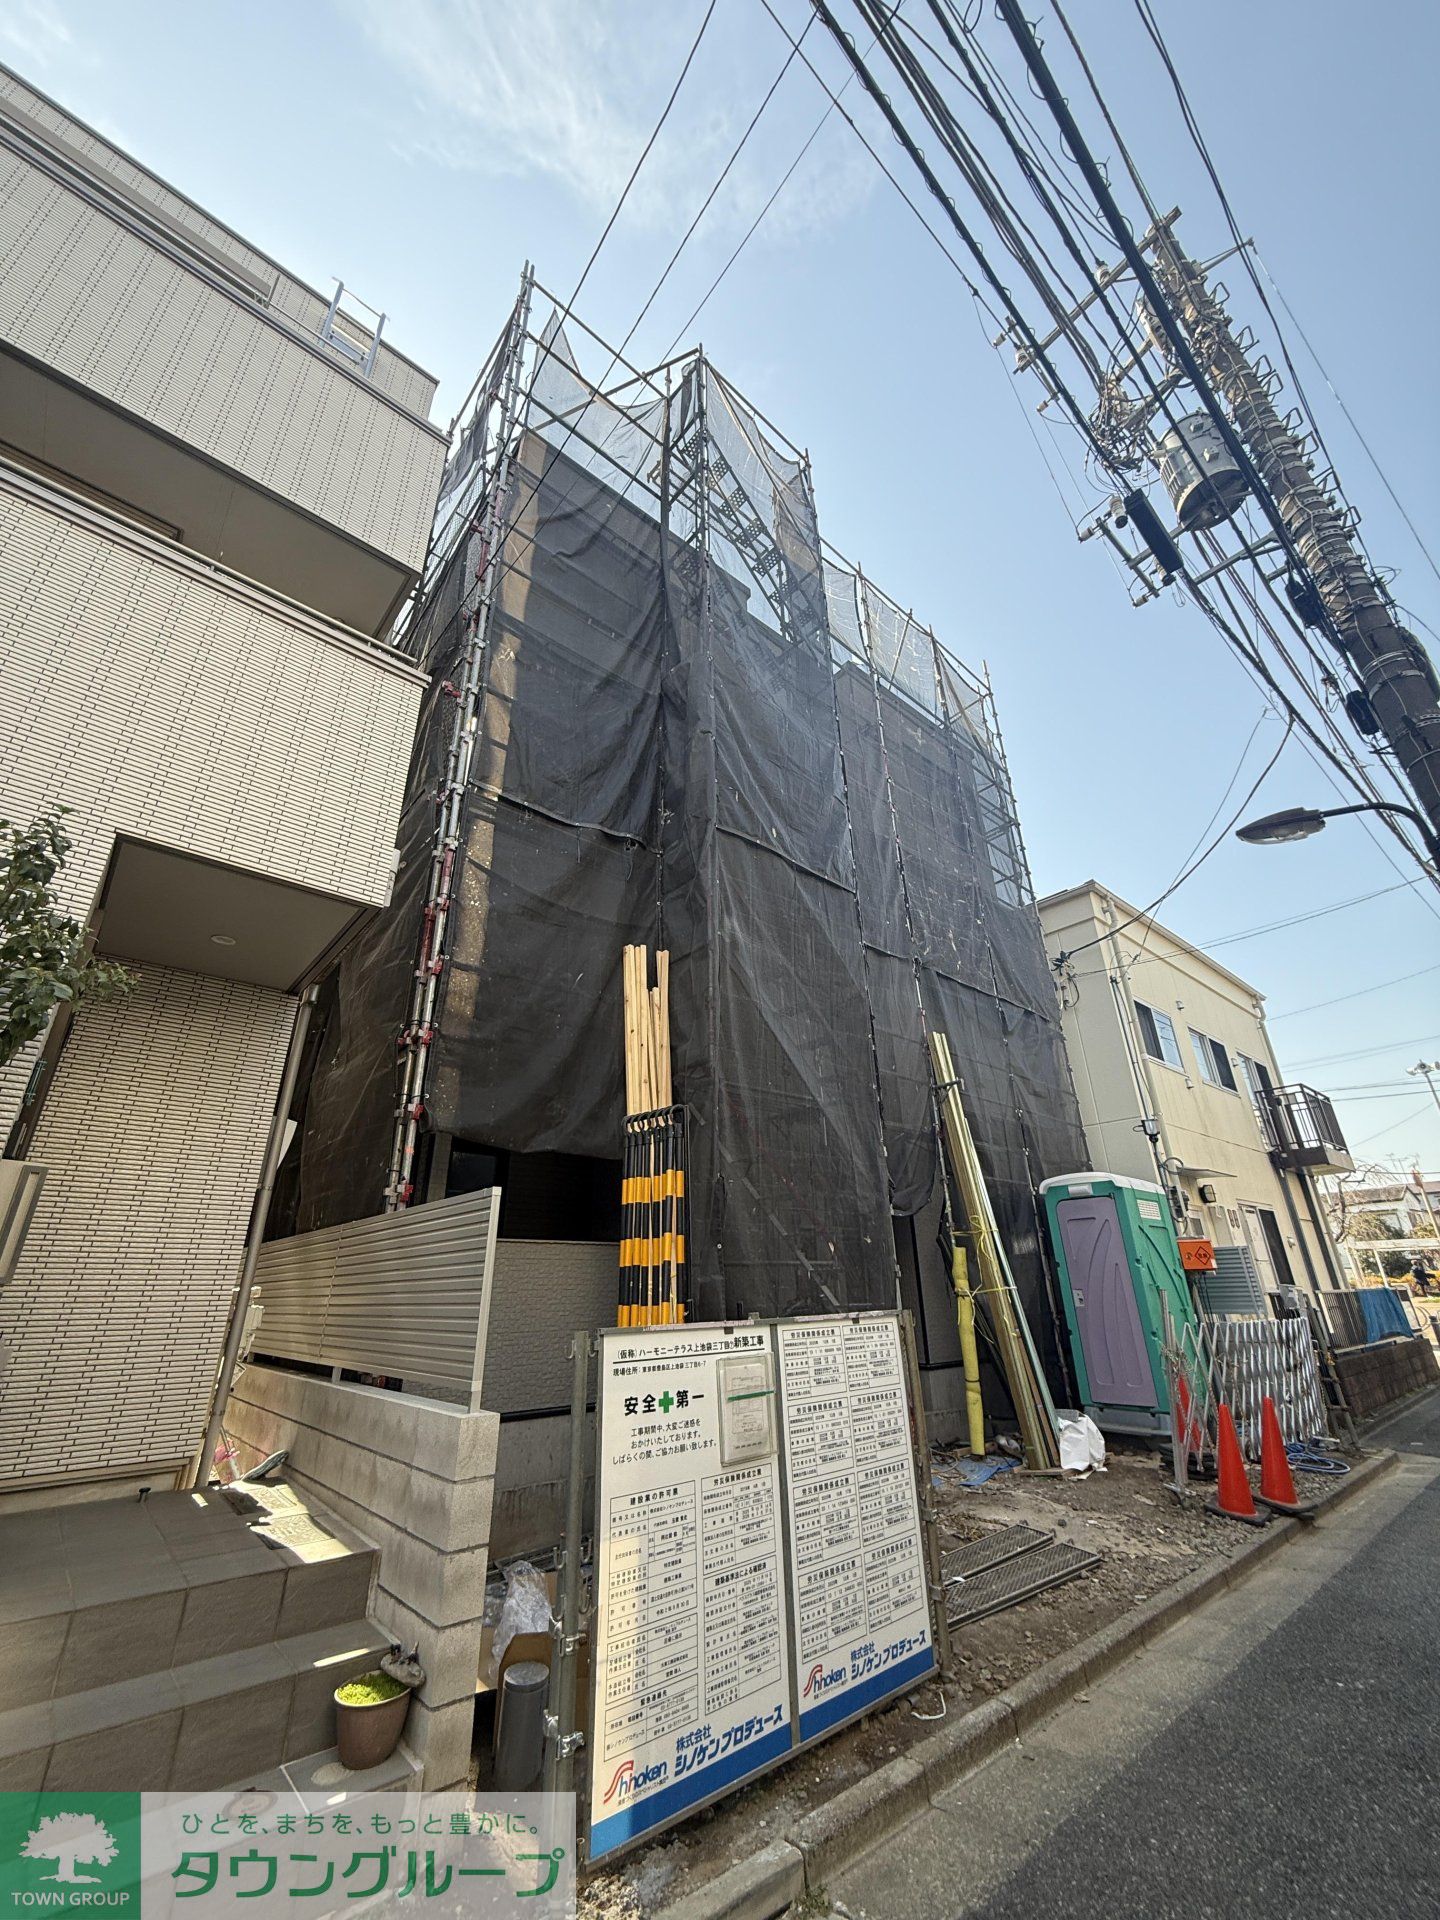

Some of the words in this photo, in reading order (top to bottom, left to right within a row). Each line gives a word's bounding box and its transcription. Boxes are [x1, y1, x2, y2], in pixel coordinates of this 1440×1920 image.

[624, 1393, 656, 1416] 安全
[676, 1387, 704, 1408] 第一
[631, 1419, 700, 1437] 工事期間中、大変ご迷惑を
[631, 1429, 700, 1449] おかけいたしております。
[613, 1440, 716, 1465] しばらくの間、ご協力お願い致します。
[850, 1640, 875, 1662] 株式会社
[851, 1630, 925, 1680] シノケンプロデュース
[675, 1704, 783, 1777] シノケンプロデュース
[676, 1722, 711, 1754] 株式会社
